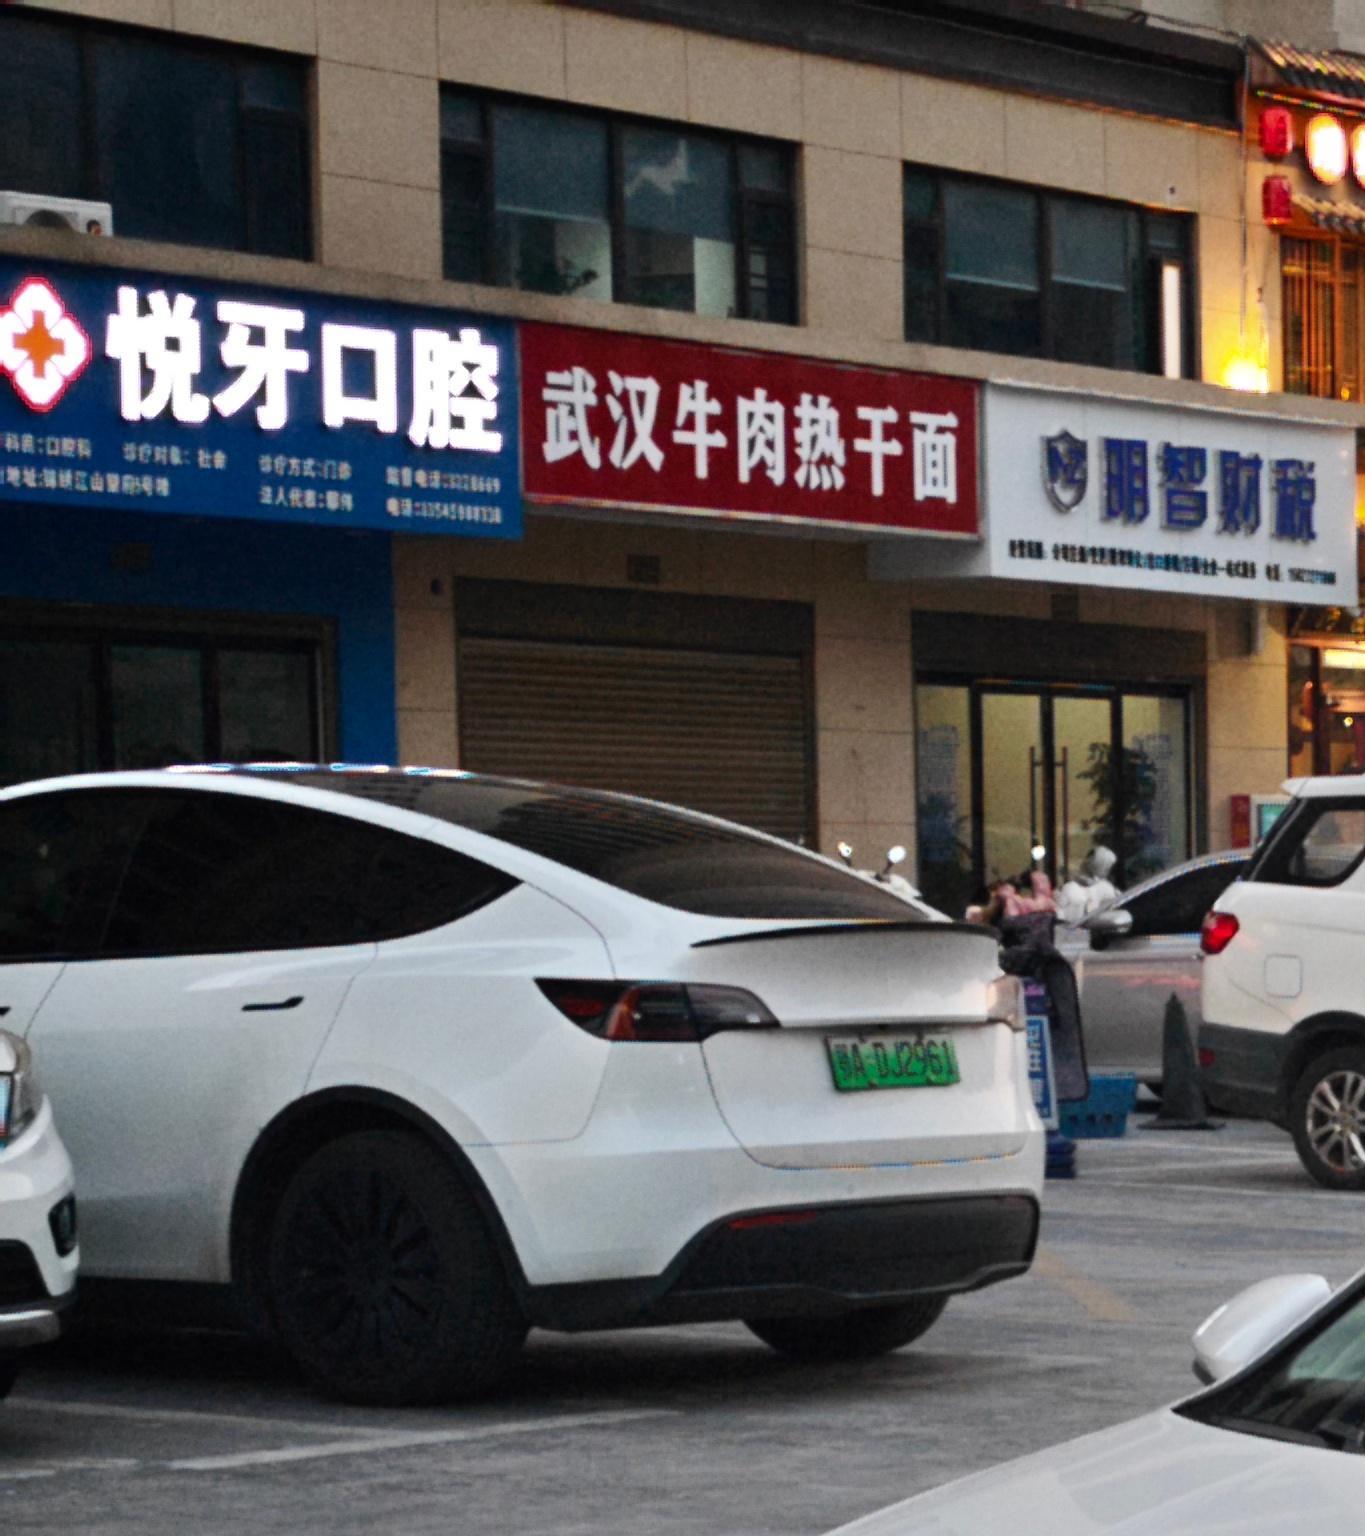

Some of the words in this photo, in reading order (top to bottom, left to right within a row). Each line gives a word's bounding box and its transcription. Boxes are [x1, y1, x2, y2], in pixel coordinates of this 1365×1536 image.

[105, 284, 503, 454] 悦牙口腔
[541, 366, 959, 504] 武汉牛肉热干面
[1101, 437, 1317, 543] 明智财税
